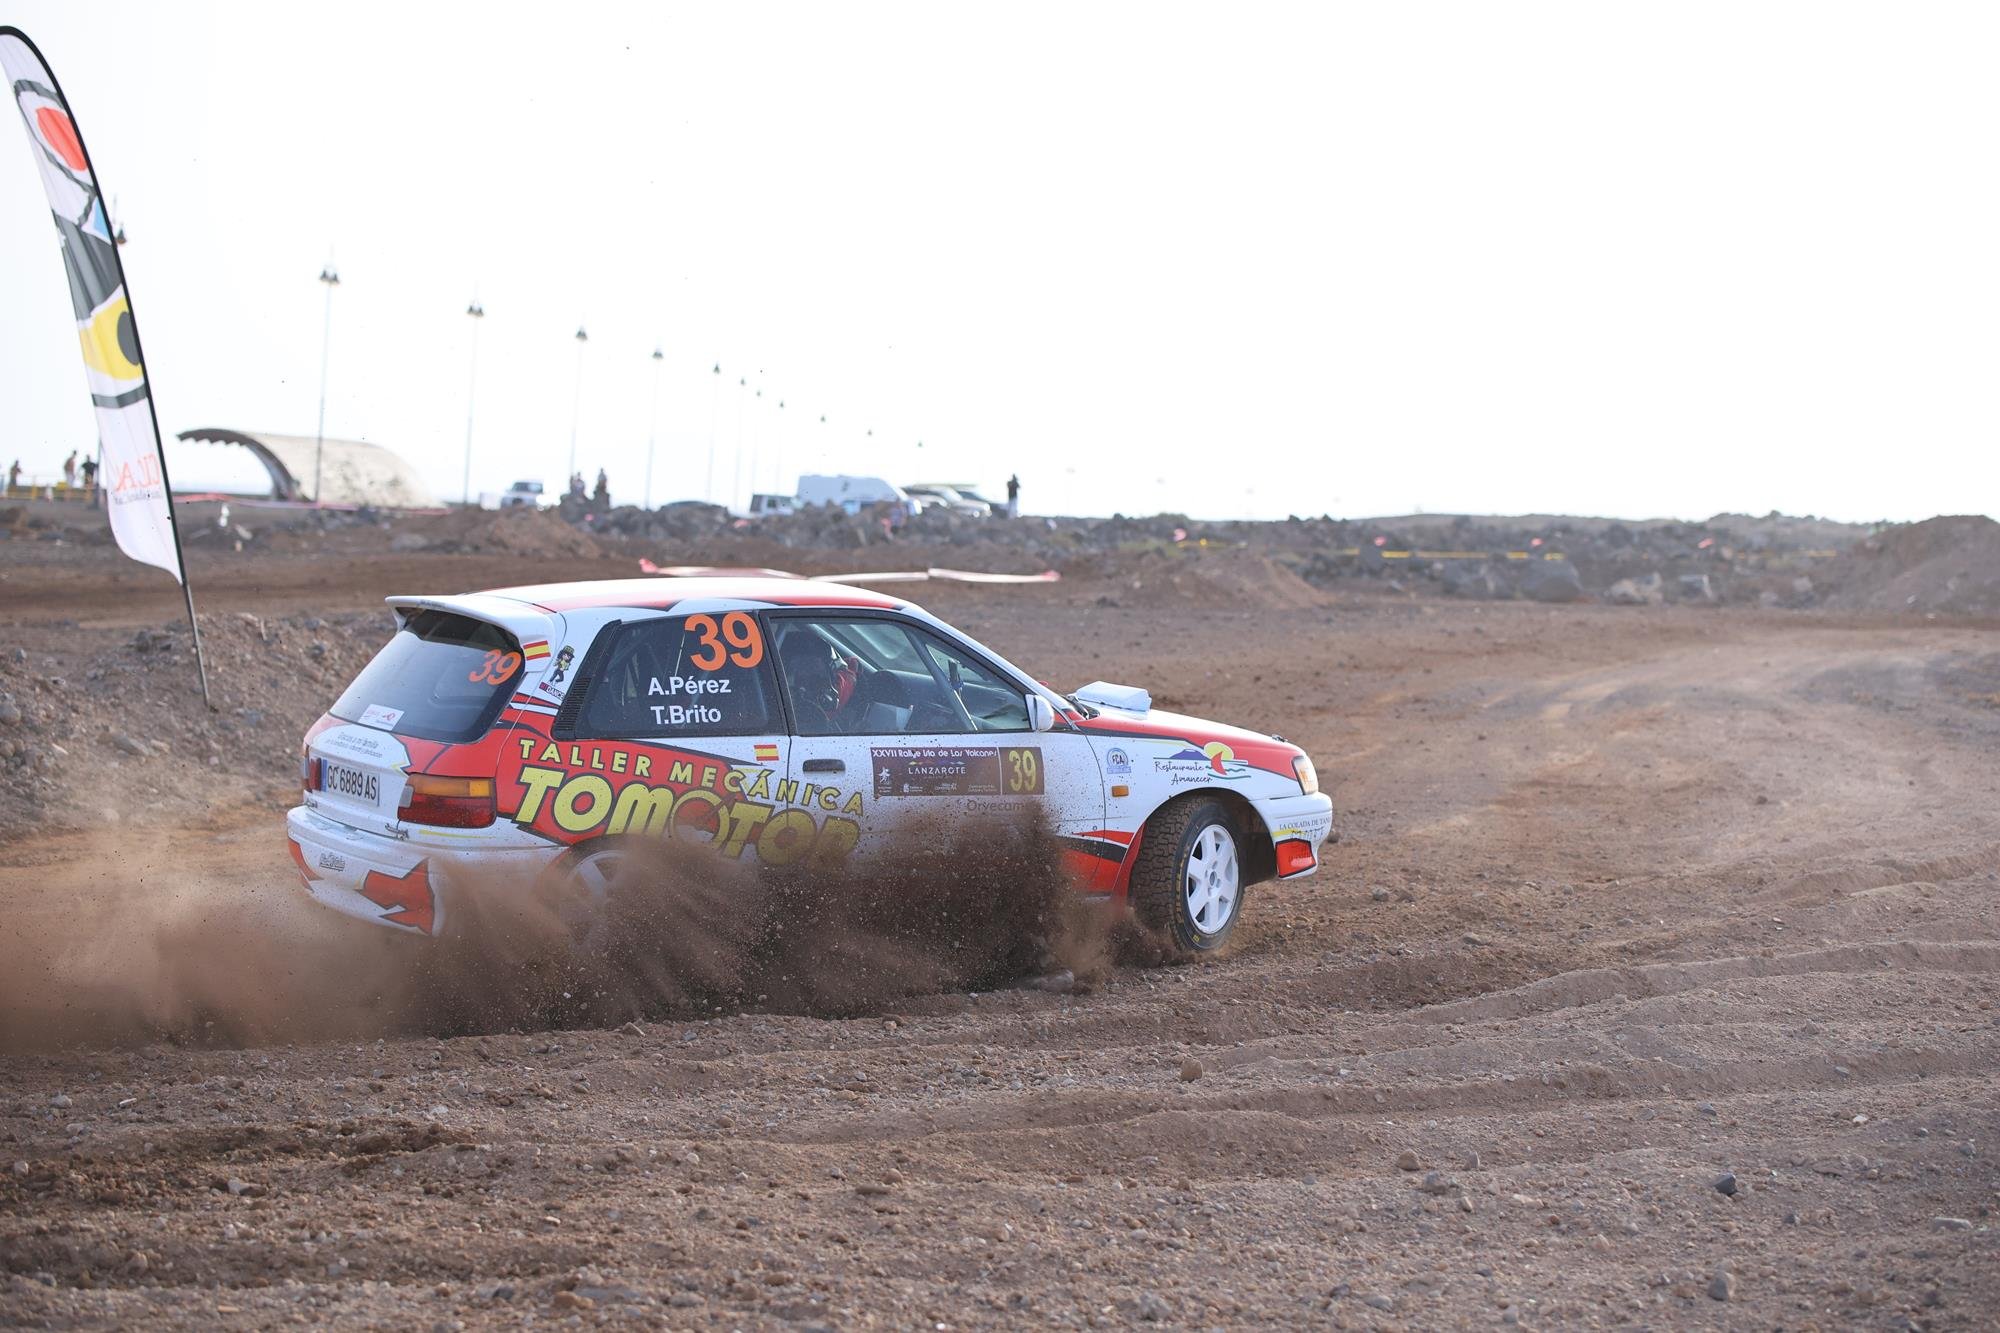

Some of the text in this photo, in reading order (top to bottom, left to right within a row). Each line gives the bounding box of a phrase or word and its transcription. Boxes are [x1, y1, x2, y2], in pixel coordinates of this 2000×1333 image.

[684, 611, 764, 671] 39
[469, 648, 521, 686] 39
[647, 675, 732, 696] A.Pérez
[650, 704, 722, 725] T.Brito
[871, 749, 898, 758] XXVII
[898, 749, 921, 759] Rallye
[938, 749, 949, 757] de
[519, 738, 864, 816] TALLER MECÁNICA
[908, 766, 967, 776] LANZAROTE
[1008, 750, 1037, 792] 39
[1153, 761, 1205, 773] Restaurante
[327, 765, 377, 800] GC 6889 AS
[1171, 773, 1213, 785] Amanecer
[967, 799, 1025, 812] Orvecam
